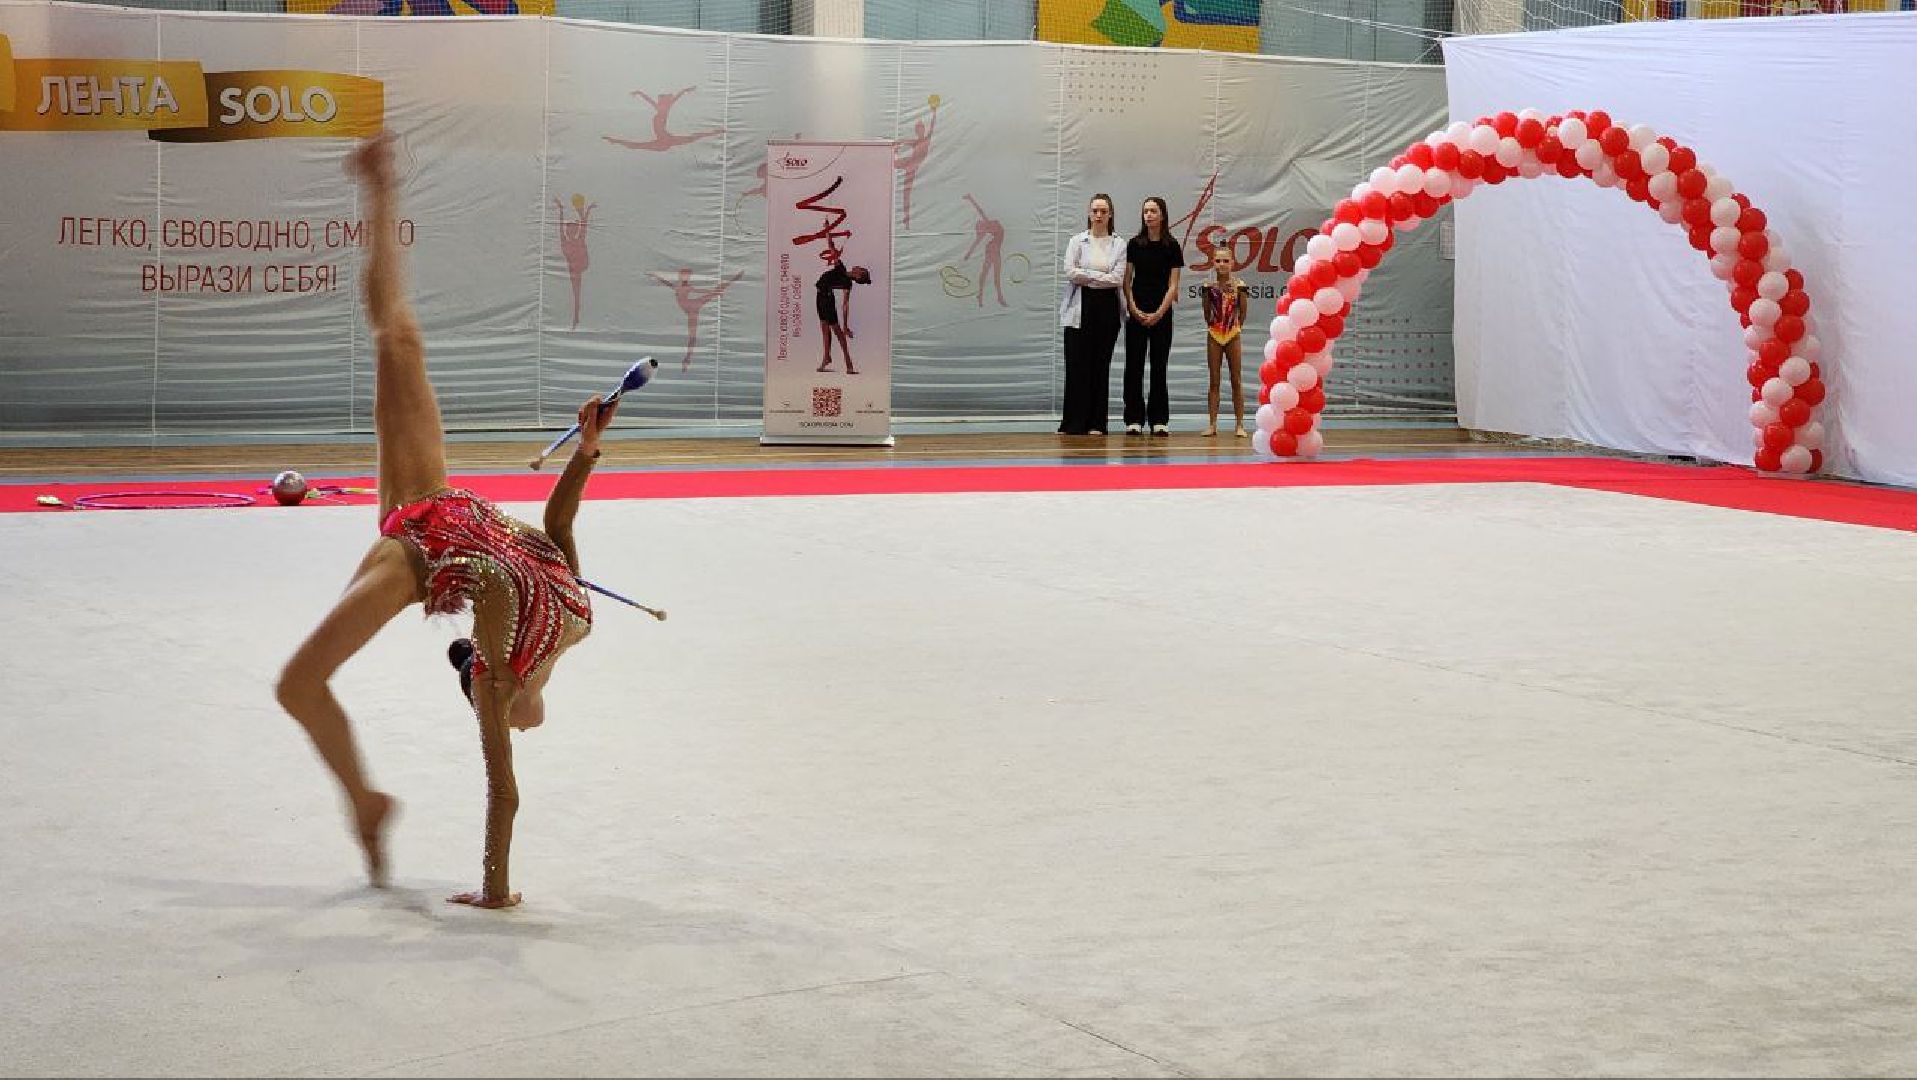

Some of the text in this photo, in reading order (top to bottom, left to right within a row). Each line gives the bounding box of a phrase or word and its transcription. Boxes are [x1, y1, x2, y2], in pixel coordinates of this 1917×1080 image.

[36, 75, 180, 116] ЛЕНТА
[218, 85, 338, 125] SOLO
[57, 216, 153, 251] ЛЕГКО,
[162, 218, 315, 252] СВОБОДНО,
[141, 264, 338, 294] ВЫРАЗИ СЕБЯ!
